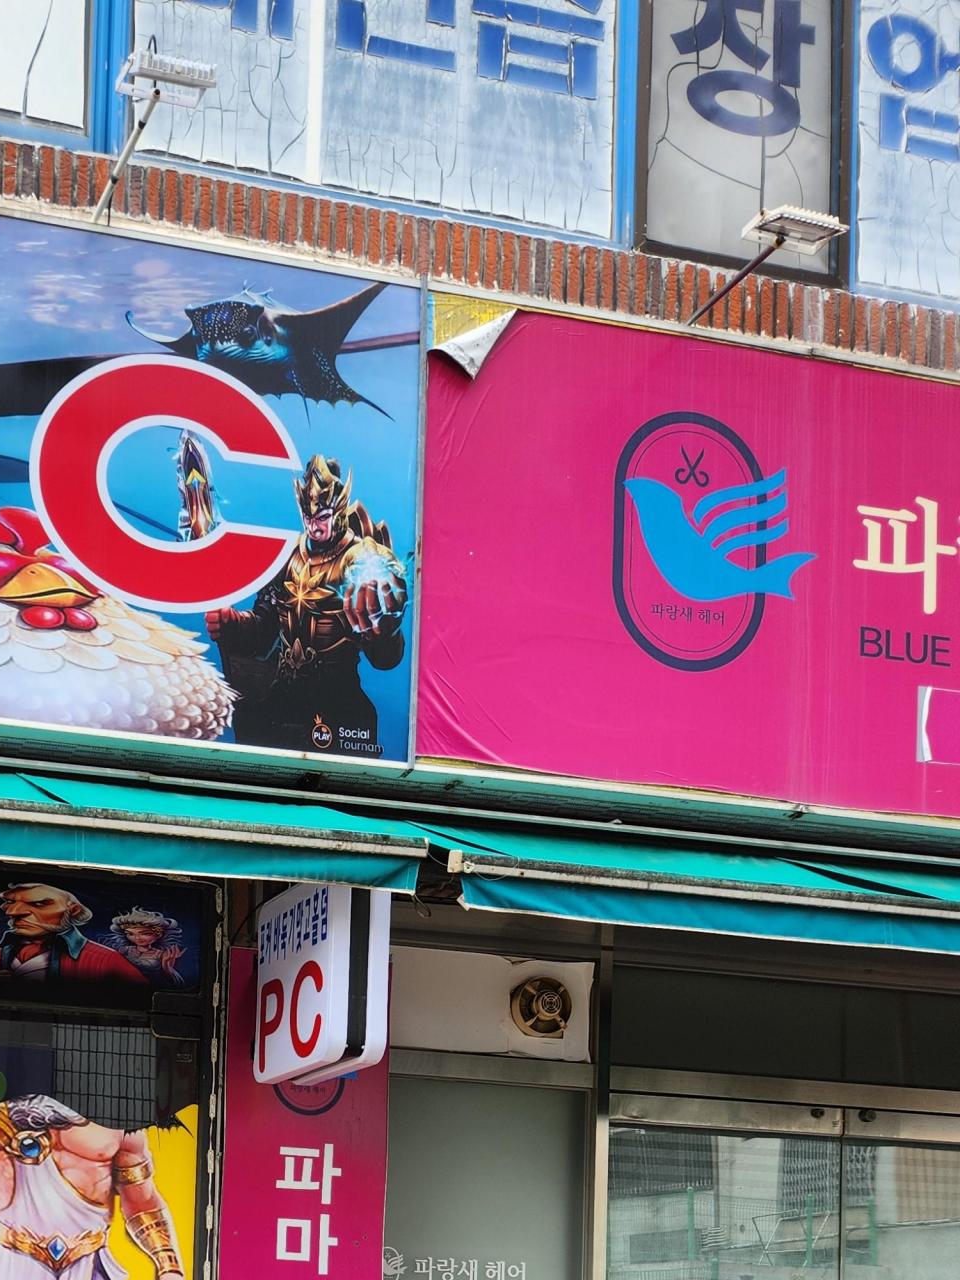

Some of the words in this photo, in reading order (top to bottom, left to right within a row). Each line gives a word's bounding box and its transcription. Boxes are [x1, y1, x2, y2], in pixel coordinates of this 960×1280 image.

[649, 603, 693, 623] 파랑새
[698, 607, 726, 626] 헤어
[859, 626, 951, 667] BLUE
[313, 732, 331, 741] PLAY
[338, 727, 370, 739] Social
[258, 960, 324, 1074] PC
[274, 1143, 342, 1276] 파마
